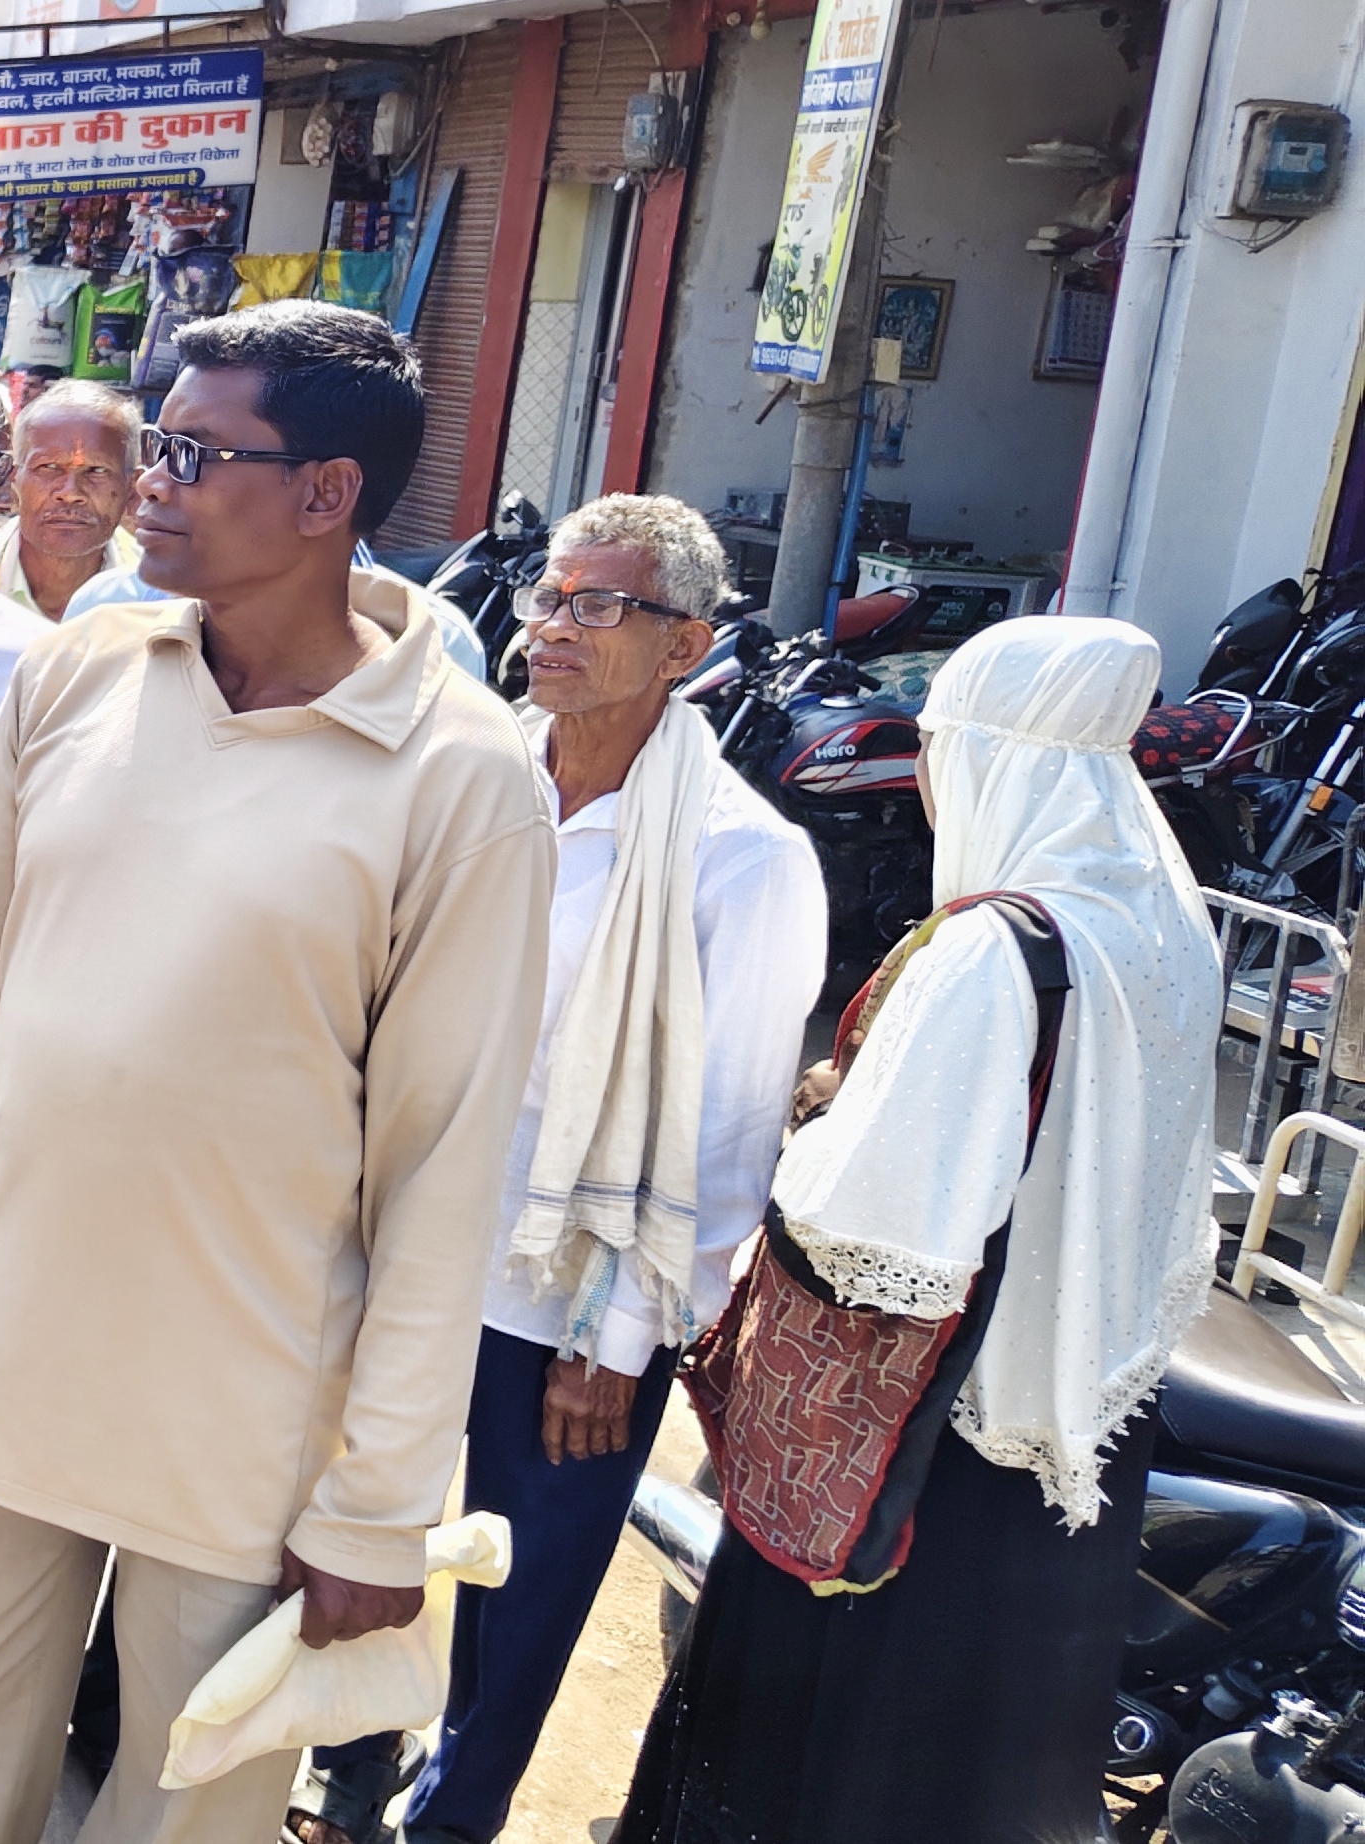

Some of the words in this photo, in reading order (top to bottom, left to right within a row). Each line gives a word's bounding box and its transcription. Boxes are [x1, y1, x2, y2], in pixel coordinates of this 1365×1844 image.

[19, 71, 58, 87] ज्वार,
[62, 68, 111, 84] बाजरा,
[116, 63, 165, 80] मक्का,
[169, 57, 201, 76] रागी
[32, 88, 75, 110] इटली
[143, 83, 180, 100] आटा
[183, 78, 233, 97] मिलता
[73, 110, 128, 144] की
[139, 109, 252, 149] दुकान
[35, 161, 63, 172] आटा
[67, 157, 87, 170] तेल
[91, 155, 103, 169] के
[107, 154, 135, 168] थोक
[138, 151, 156, 165] एवं
[200, 148, 239, 161] विक्रेता
[16, 182, 49, 198] प्रकार
[52, 180, 65, 193] के
[97, 175, 138, 190] मसाला
[140, 172, 187, 188] उपलब्ध
[188, 169, 199, 187] है
[814, 743, 857, 760] Hero
